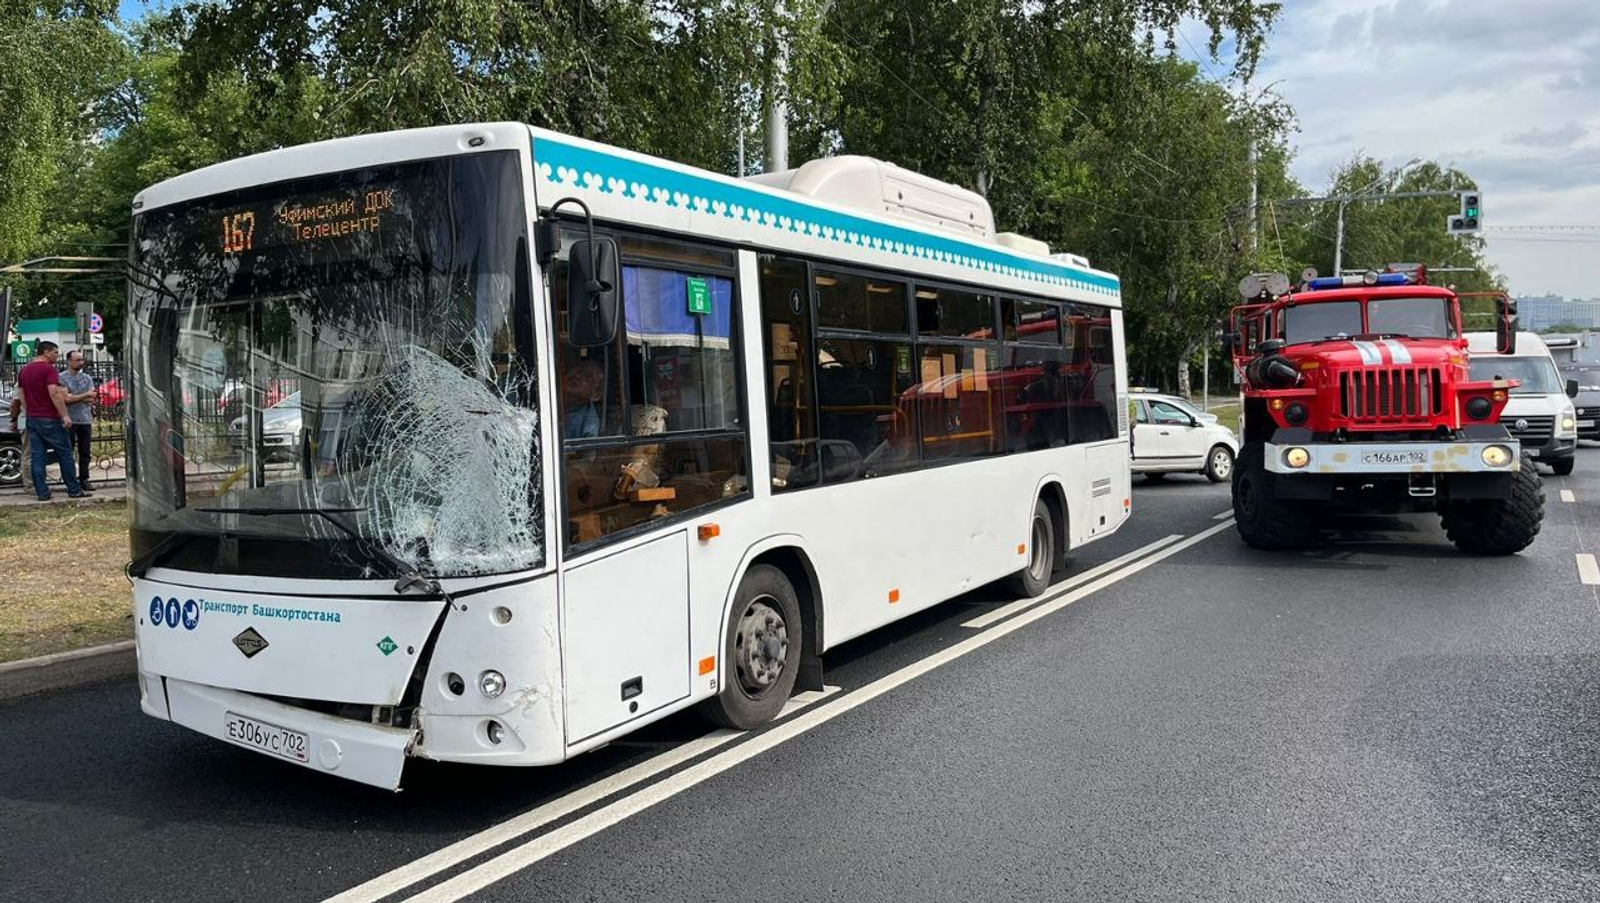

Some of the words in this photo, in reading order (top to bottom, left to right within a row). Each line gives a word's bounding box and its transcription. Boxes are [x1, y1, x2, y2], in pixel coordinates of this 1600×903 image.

[278, 198, 355, 224] Уфимский
[365, 188, 396, 214] ДОК
[222, 211, 255, 252] 167
[292, 216, 381, 240] Телецентр
[199, 599, 248, 614] Транспорт
[252, 603, 341, 622] Башкортостана
